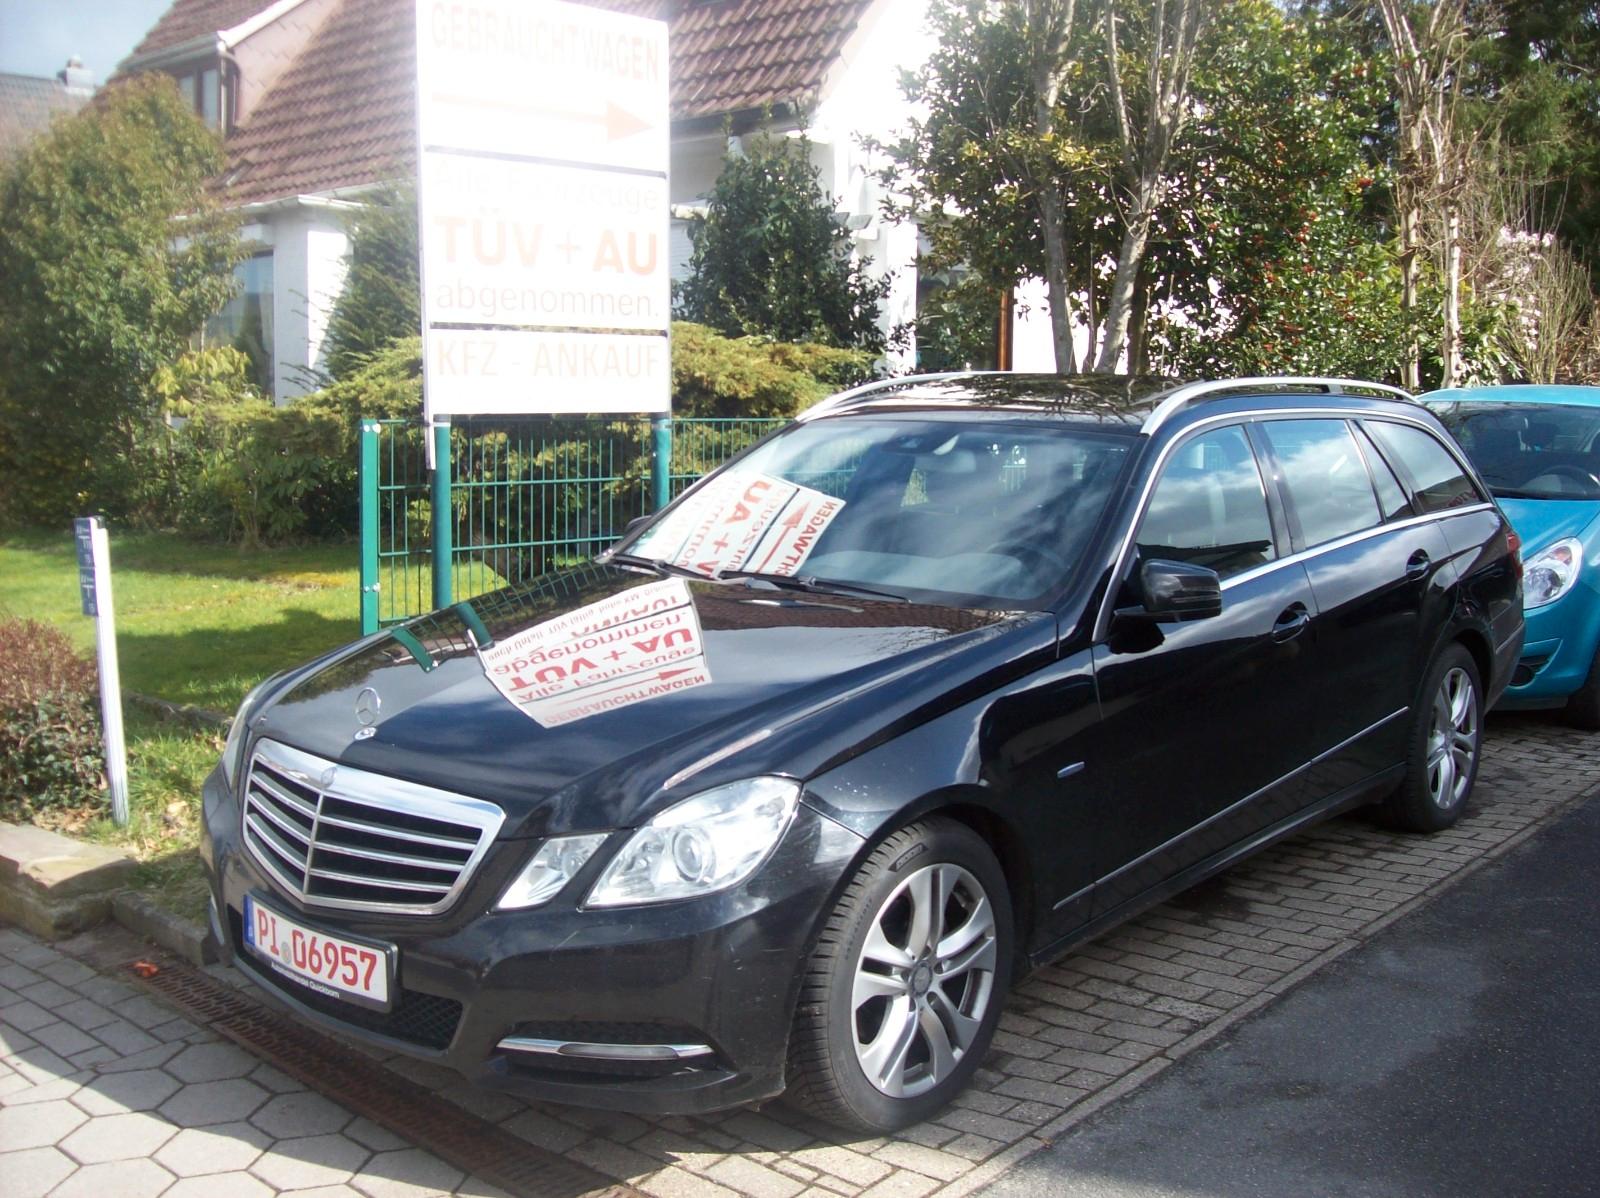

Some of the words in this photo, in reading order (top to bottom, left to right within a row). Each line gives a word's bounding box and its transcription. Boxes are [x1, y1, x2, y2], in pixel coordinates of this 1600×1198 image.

[432, 1, 660, 83] GEBRAUCHTWAGEN
[433, 205, 544, 268] TÜV
[556, 231, 581, 265] +
[592, 229, 657, 276] AU
[435, 278, 659, 318] abgenommen.
[437, 338, 498, 377] KFZ
[533, 341, 659, 379] ANKAUF
[258, 909, 279, 955] PI
[291, 929, 377, 991] 06957
